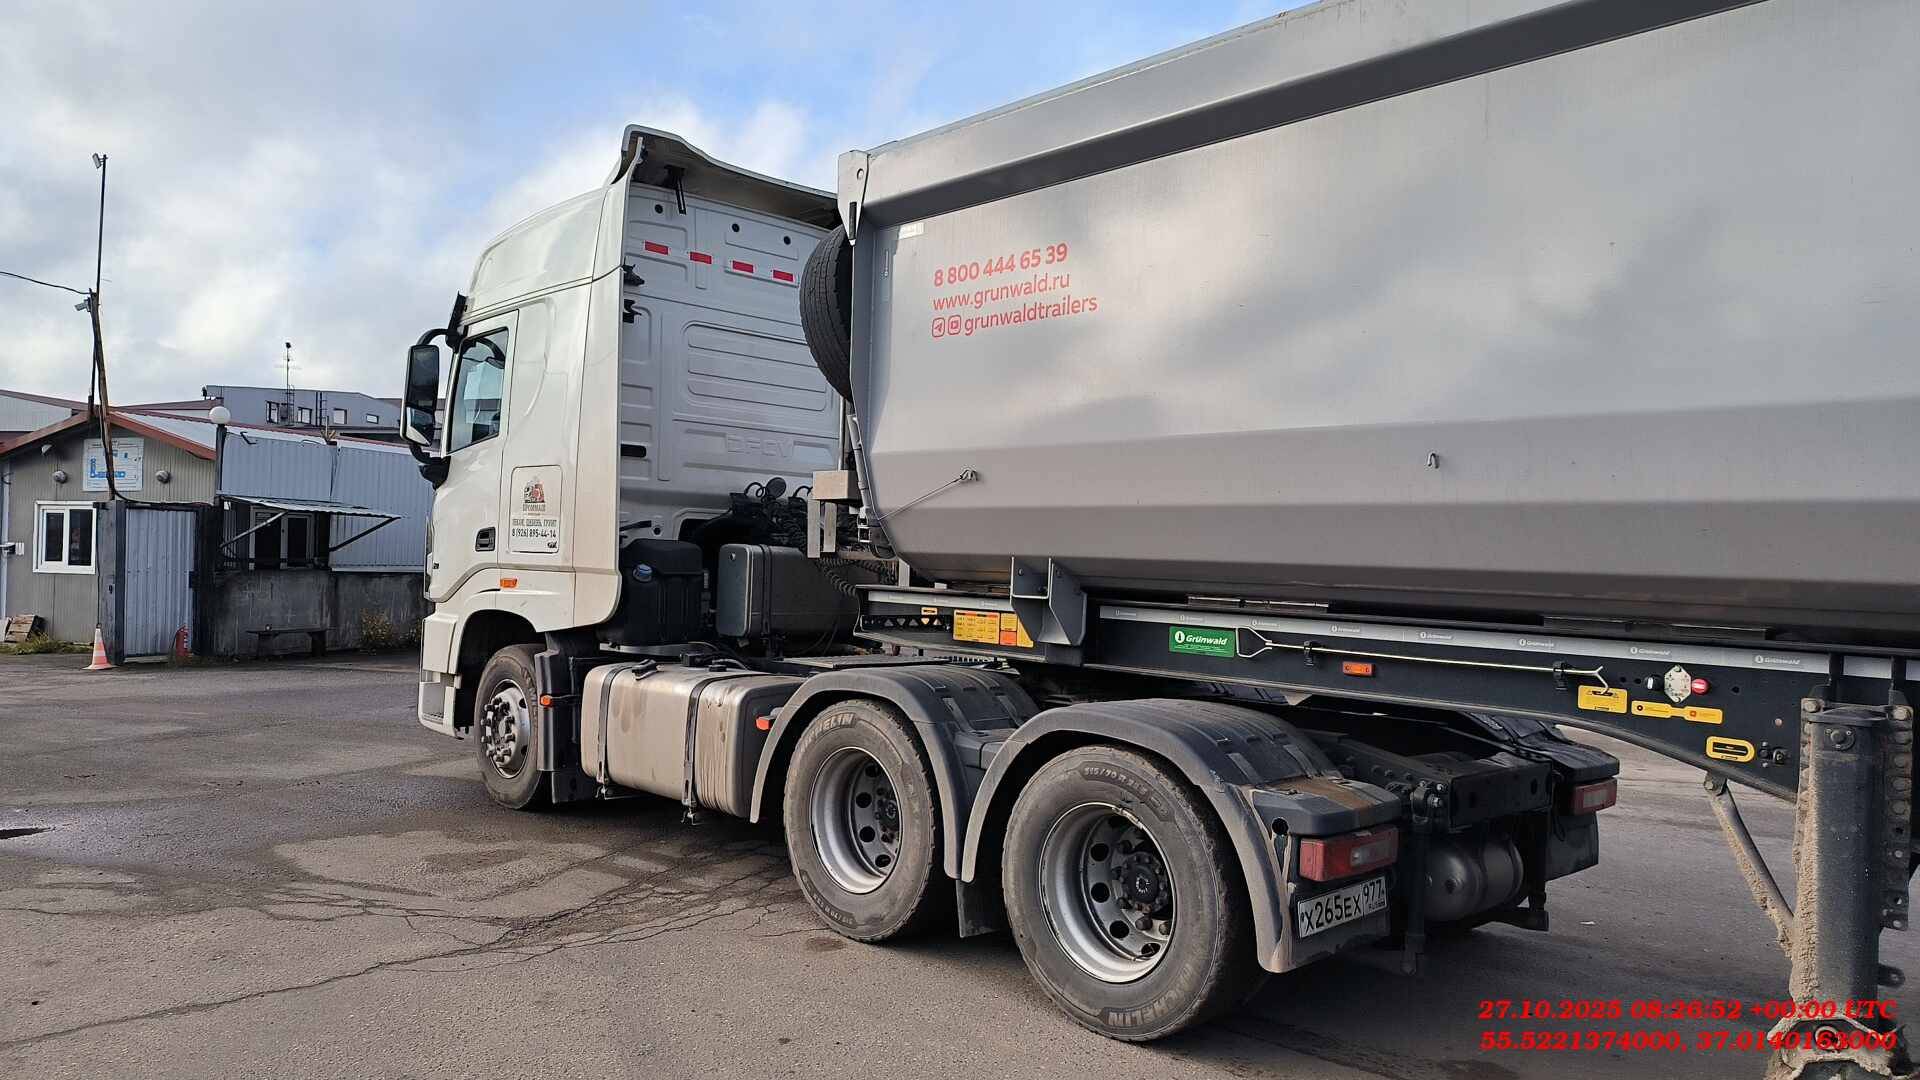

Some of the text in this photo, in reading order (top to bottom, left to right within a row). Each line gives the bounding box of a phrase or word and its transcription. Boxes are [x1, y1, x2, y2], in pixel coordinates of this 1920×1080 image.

[934, 243, 1068, 287] 8 800 444 65 39
[933, 272, 1070, 310] www.grunwald.ru
[964, 295, 1098, 336] grunwaldtrailers
[1186, 634, 1227, 646] Grünwald
